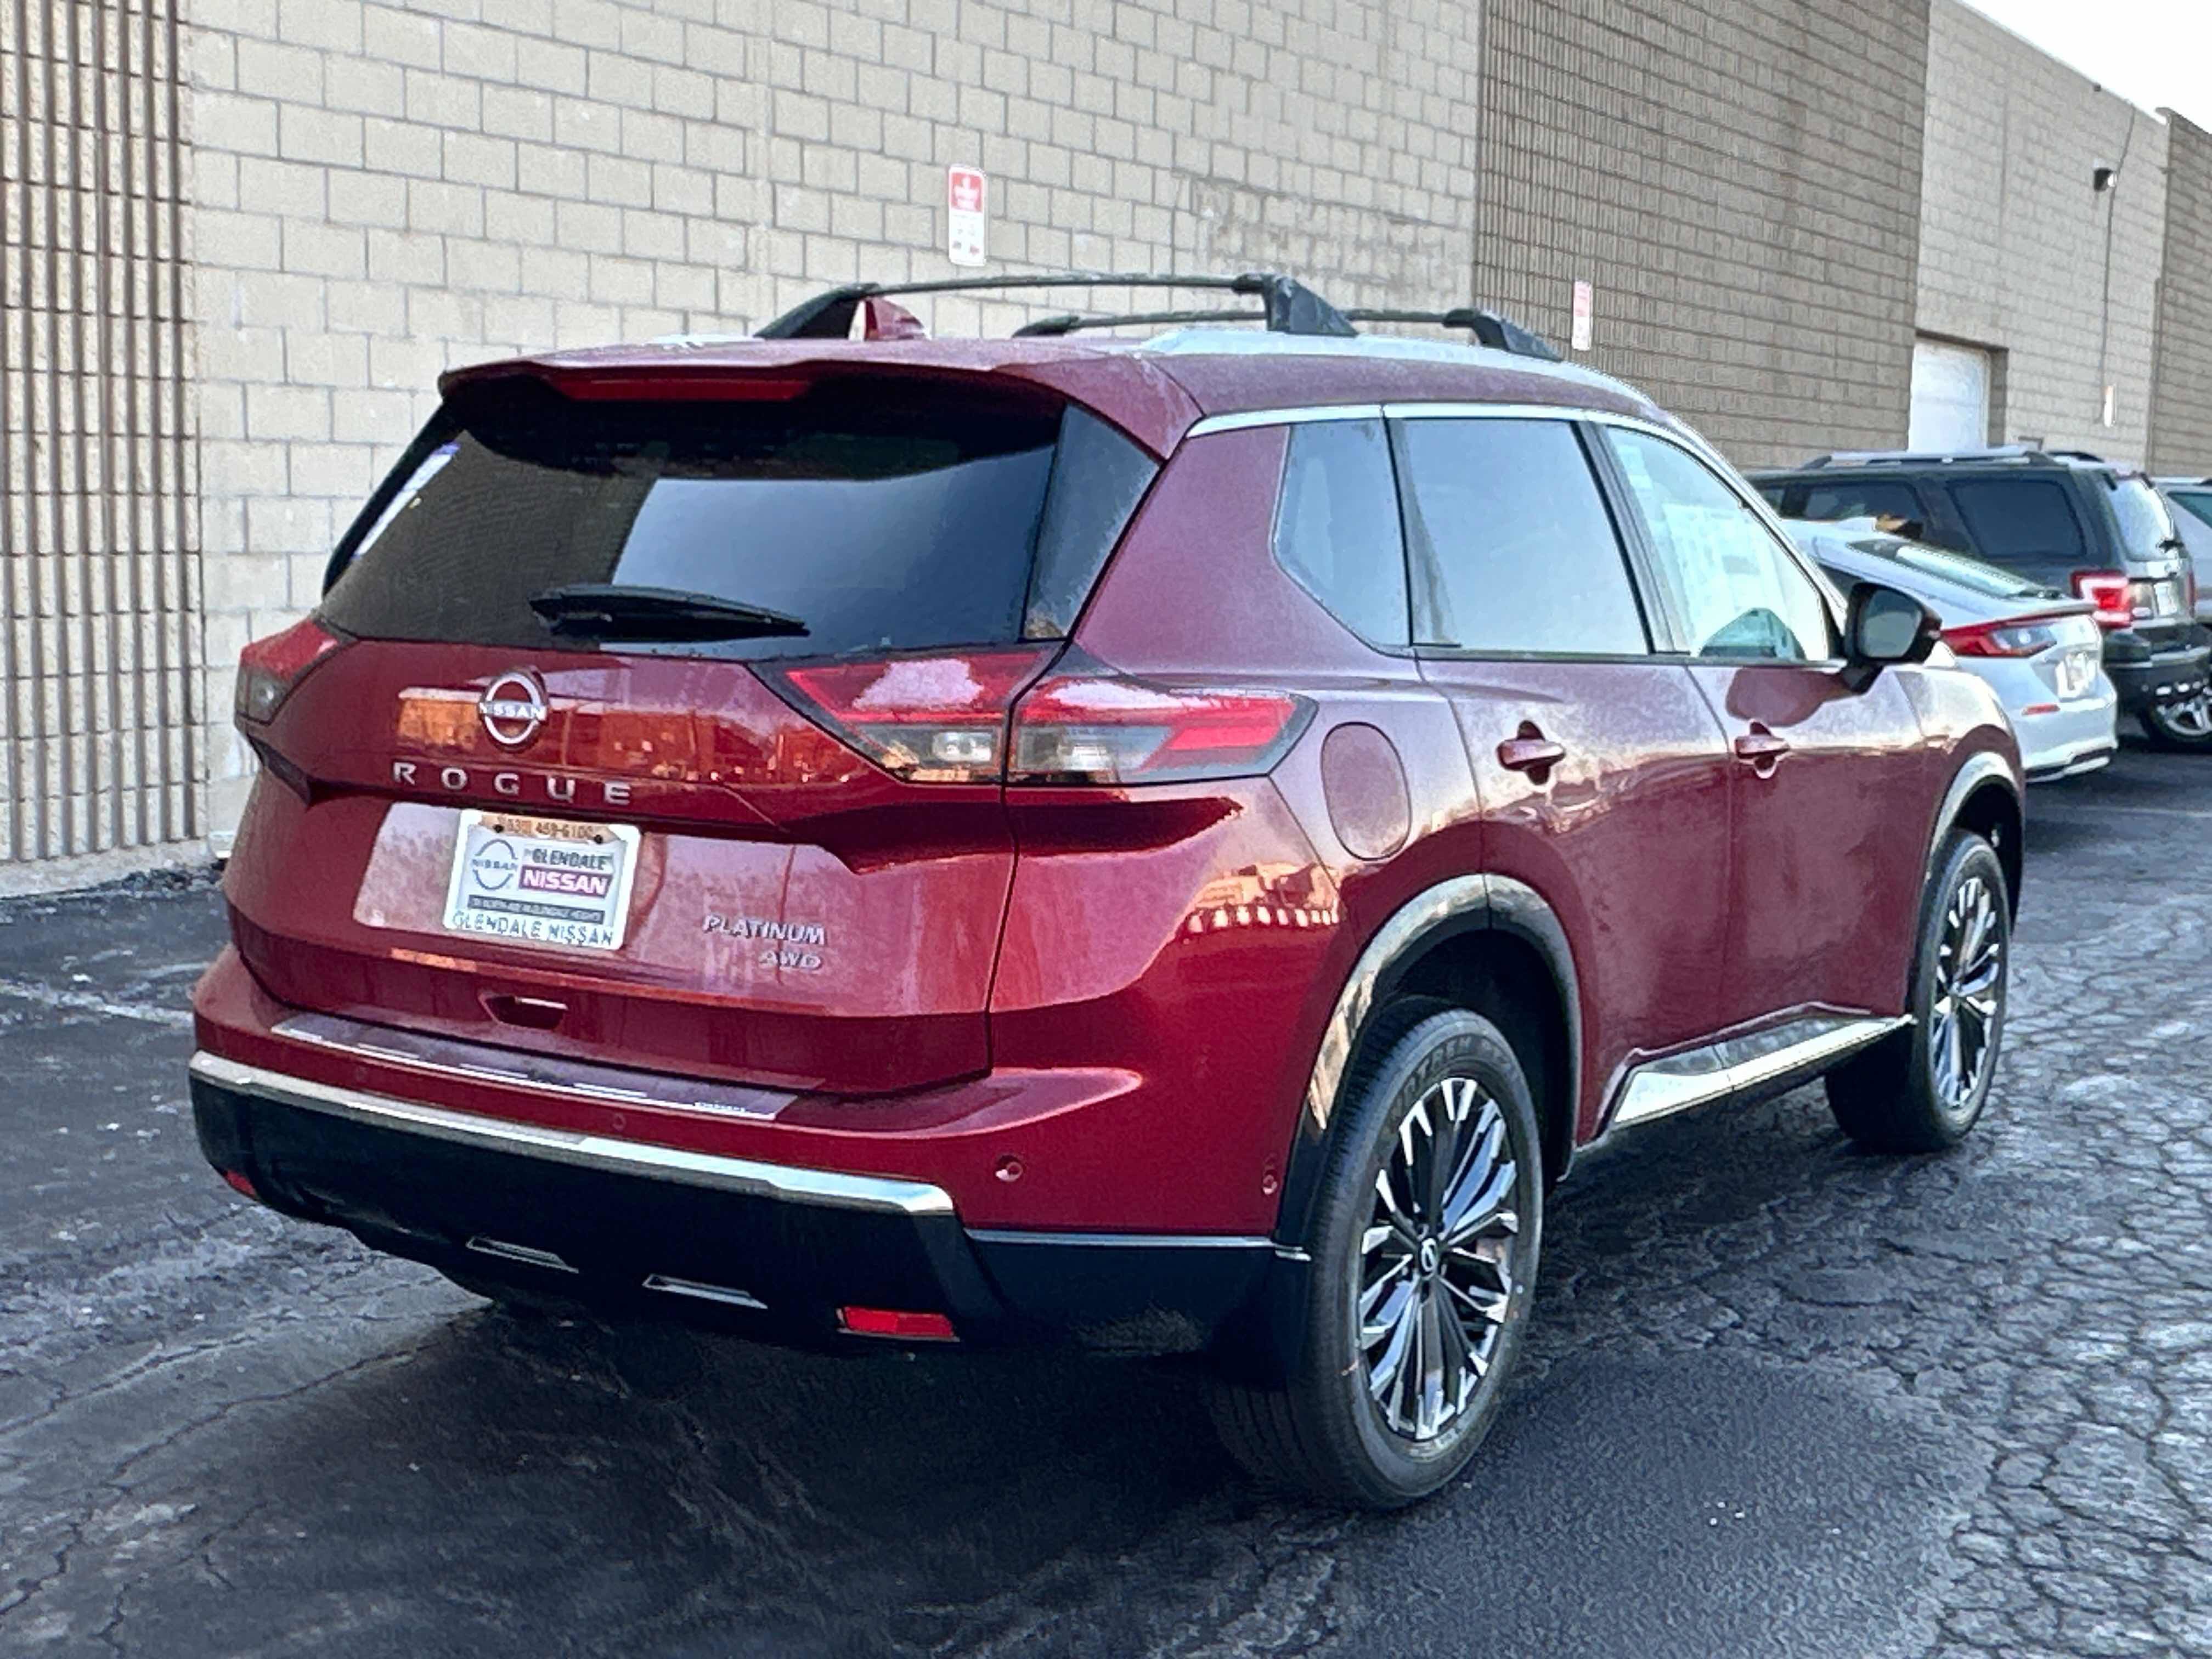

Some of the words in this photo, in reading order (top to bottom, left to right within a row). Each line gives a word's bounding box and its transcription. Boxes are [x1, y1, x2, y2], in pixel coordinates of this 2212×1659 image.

[479, 702, 546, 721] NISSAN
[392, 762, 631, 804] ROGUE
[472, 859, 518, 871] NISSAN
[532, 848, 608, 871] GLENDALE
[522, 869, 608, 895] NISSAN
[452, 911, 543, 938] GLENDALE
[549, 926, 614, 946] NISSAN
[703, 913, 827, 945] PLATINUM
[758, 949, 823, 970] AWD
